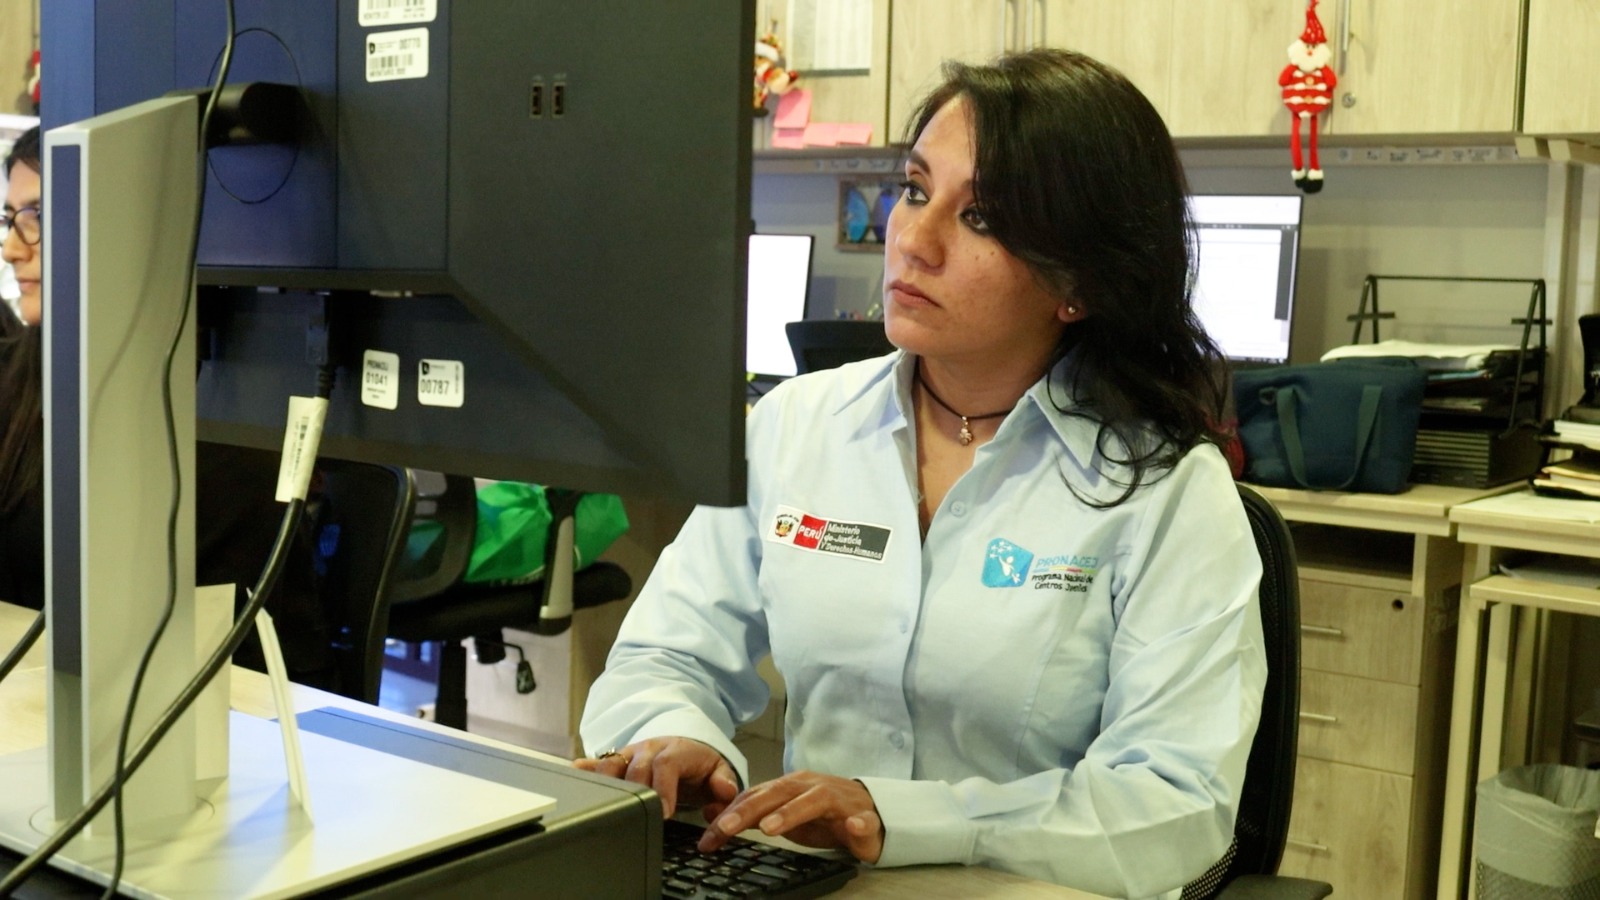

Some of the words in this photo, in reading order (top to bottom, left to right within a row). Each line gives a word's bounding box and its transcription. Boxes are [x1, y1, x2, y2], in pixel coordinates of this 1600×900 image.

[366, 372, 388, 386] 01041
[420, 378, 450, 395] 00787
[798, 525, 824, 540] PERÚ
[827, 523, 861, 535] Ministerio
[834, 535, 862, 546] Justicia
[825, 543, 853, 554] Derechos
[854, 546, 883, 559] Humanos
[1036, 556, 1098, 568] PRONACEJ
[1032, 573, 1062, 582] Programa
[1034, 581, 1063, 590] Centros
